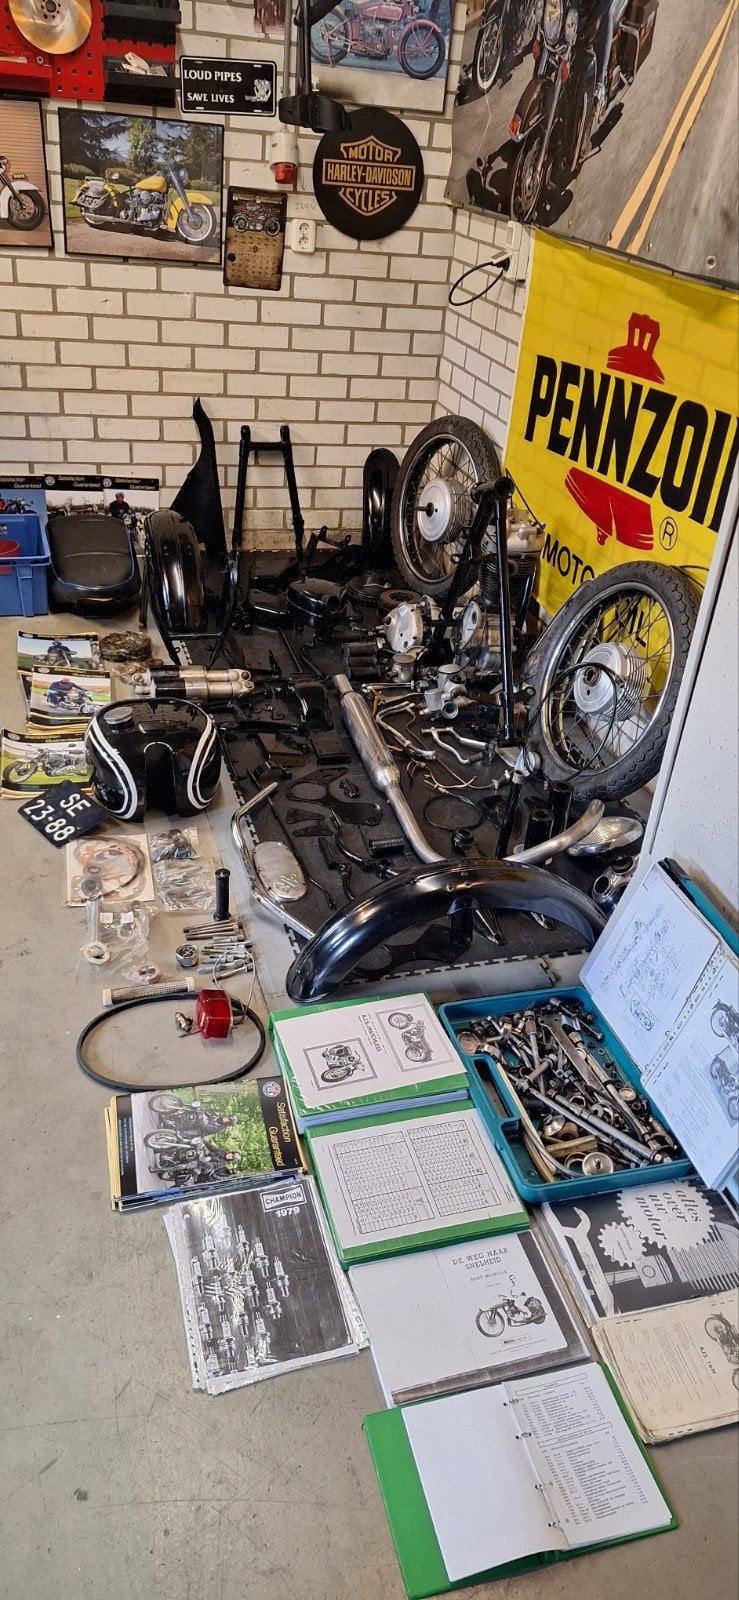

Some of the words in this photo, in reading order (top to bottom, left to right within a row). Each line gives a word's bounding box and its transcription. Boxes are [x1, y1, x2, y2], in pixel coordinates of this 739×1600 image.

[184, 70, 212, 80] LOUD
[214, 71, 242, 82] PIPES
[187, 93, 208, 102] SAVE
[211, 94, 235, 103] LIVES
[348, 141, 393, 162] MOTOR
[327, 163, 412, 186] HARLEY-DAVIDSON
[345, 187, 390, 212] CYCLES
[541, 530, 595, 585] MOTO
[60, 793, 92, 817] SE
[23, 799, 76, 841] 23-88
[276, 1101, 292, 1143] Satisfaction
[268, 1126, 287, 1167] Guaranteed
[265, 1190, 303, 1205] CHAMPION
[648, 1194, 668, 1214] uw
[662, 1192, 688, 1223] over
[675, 1190, 701, 1222] alles
[275, 1205, 301, 1218] 1979
[634, 1197, 667, 1240] motor
[452, 1257, 464, 1266] DE
[466, 1252, 485, 1262] WEG
[486, 1247, 509, 1257] NAAR
[464, 1256, 502, 1270] SNELHEID
